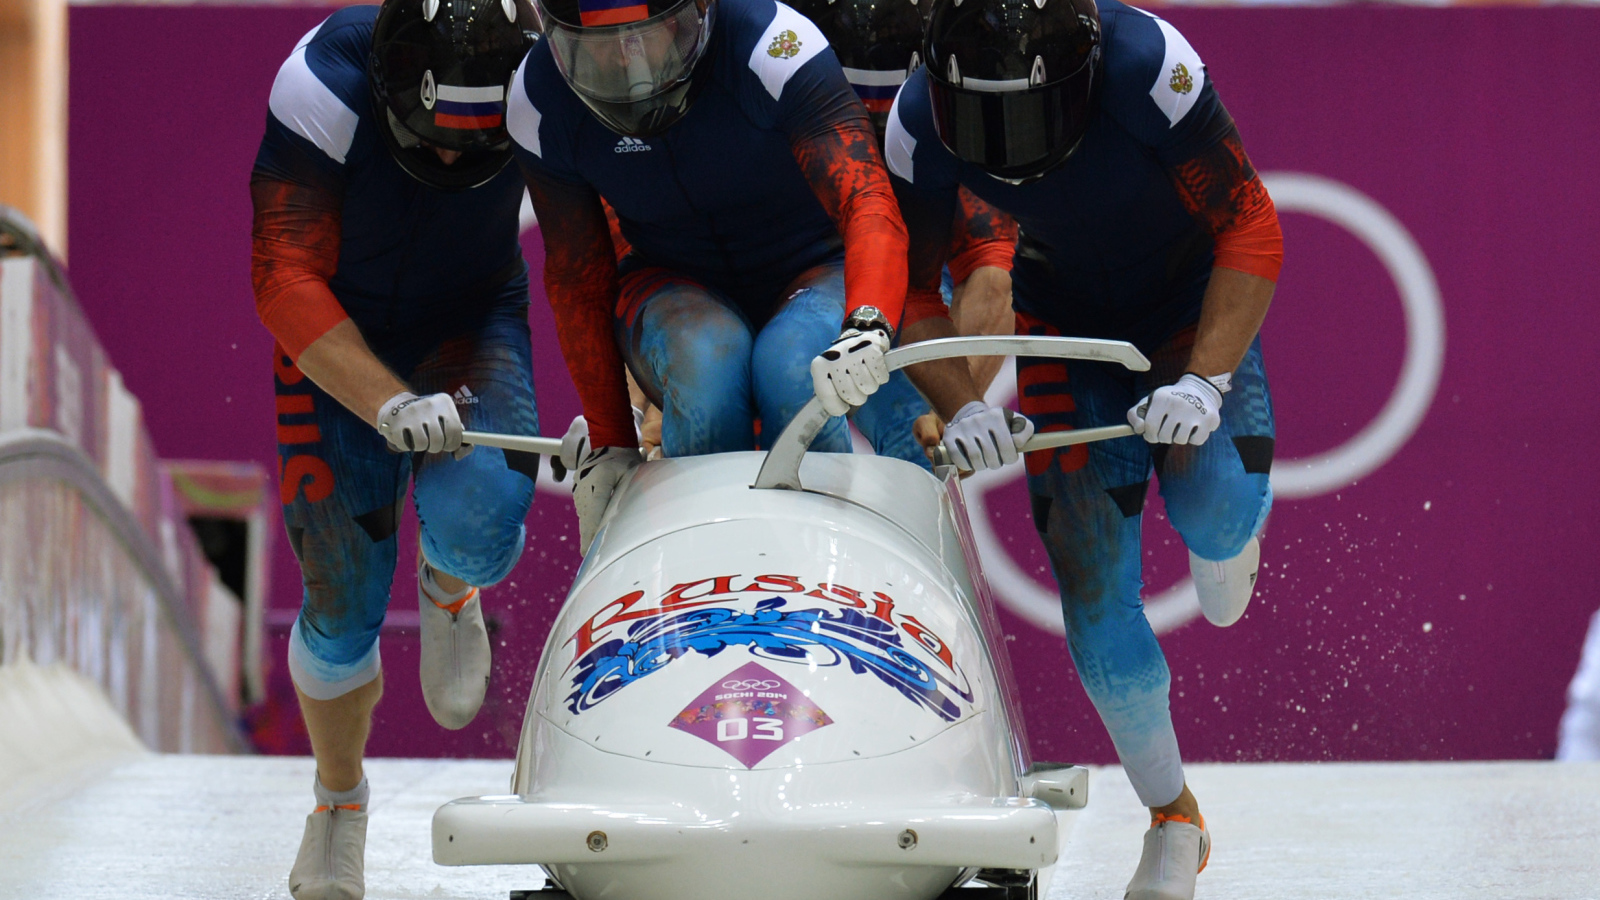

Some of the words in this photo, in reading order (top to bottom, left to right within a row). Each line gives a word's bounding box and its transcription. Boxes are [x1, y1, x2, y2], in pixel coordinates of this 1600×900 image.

[614, 144, 651, 153] adidas
[560, 574, 957, 680] Russia
[715, 692, 754, 701] SOCHI
[757, 692, 788, 700] 2014
[717, 717, 784, 742] 03
